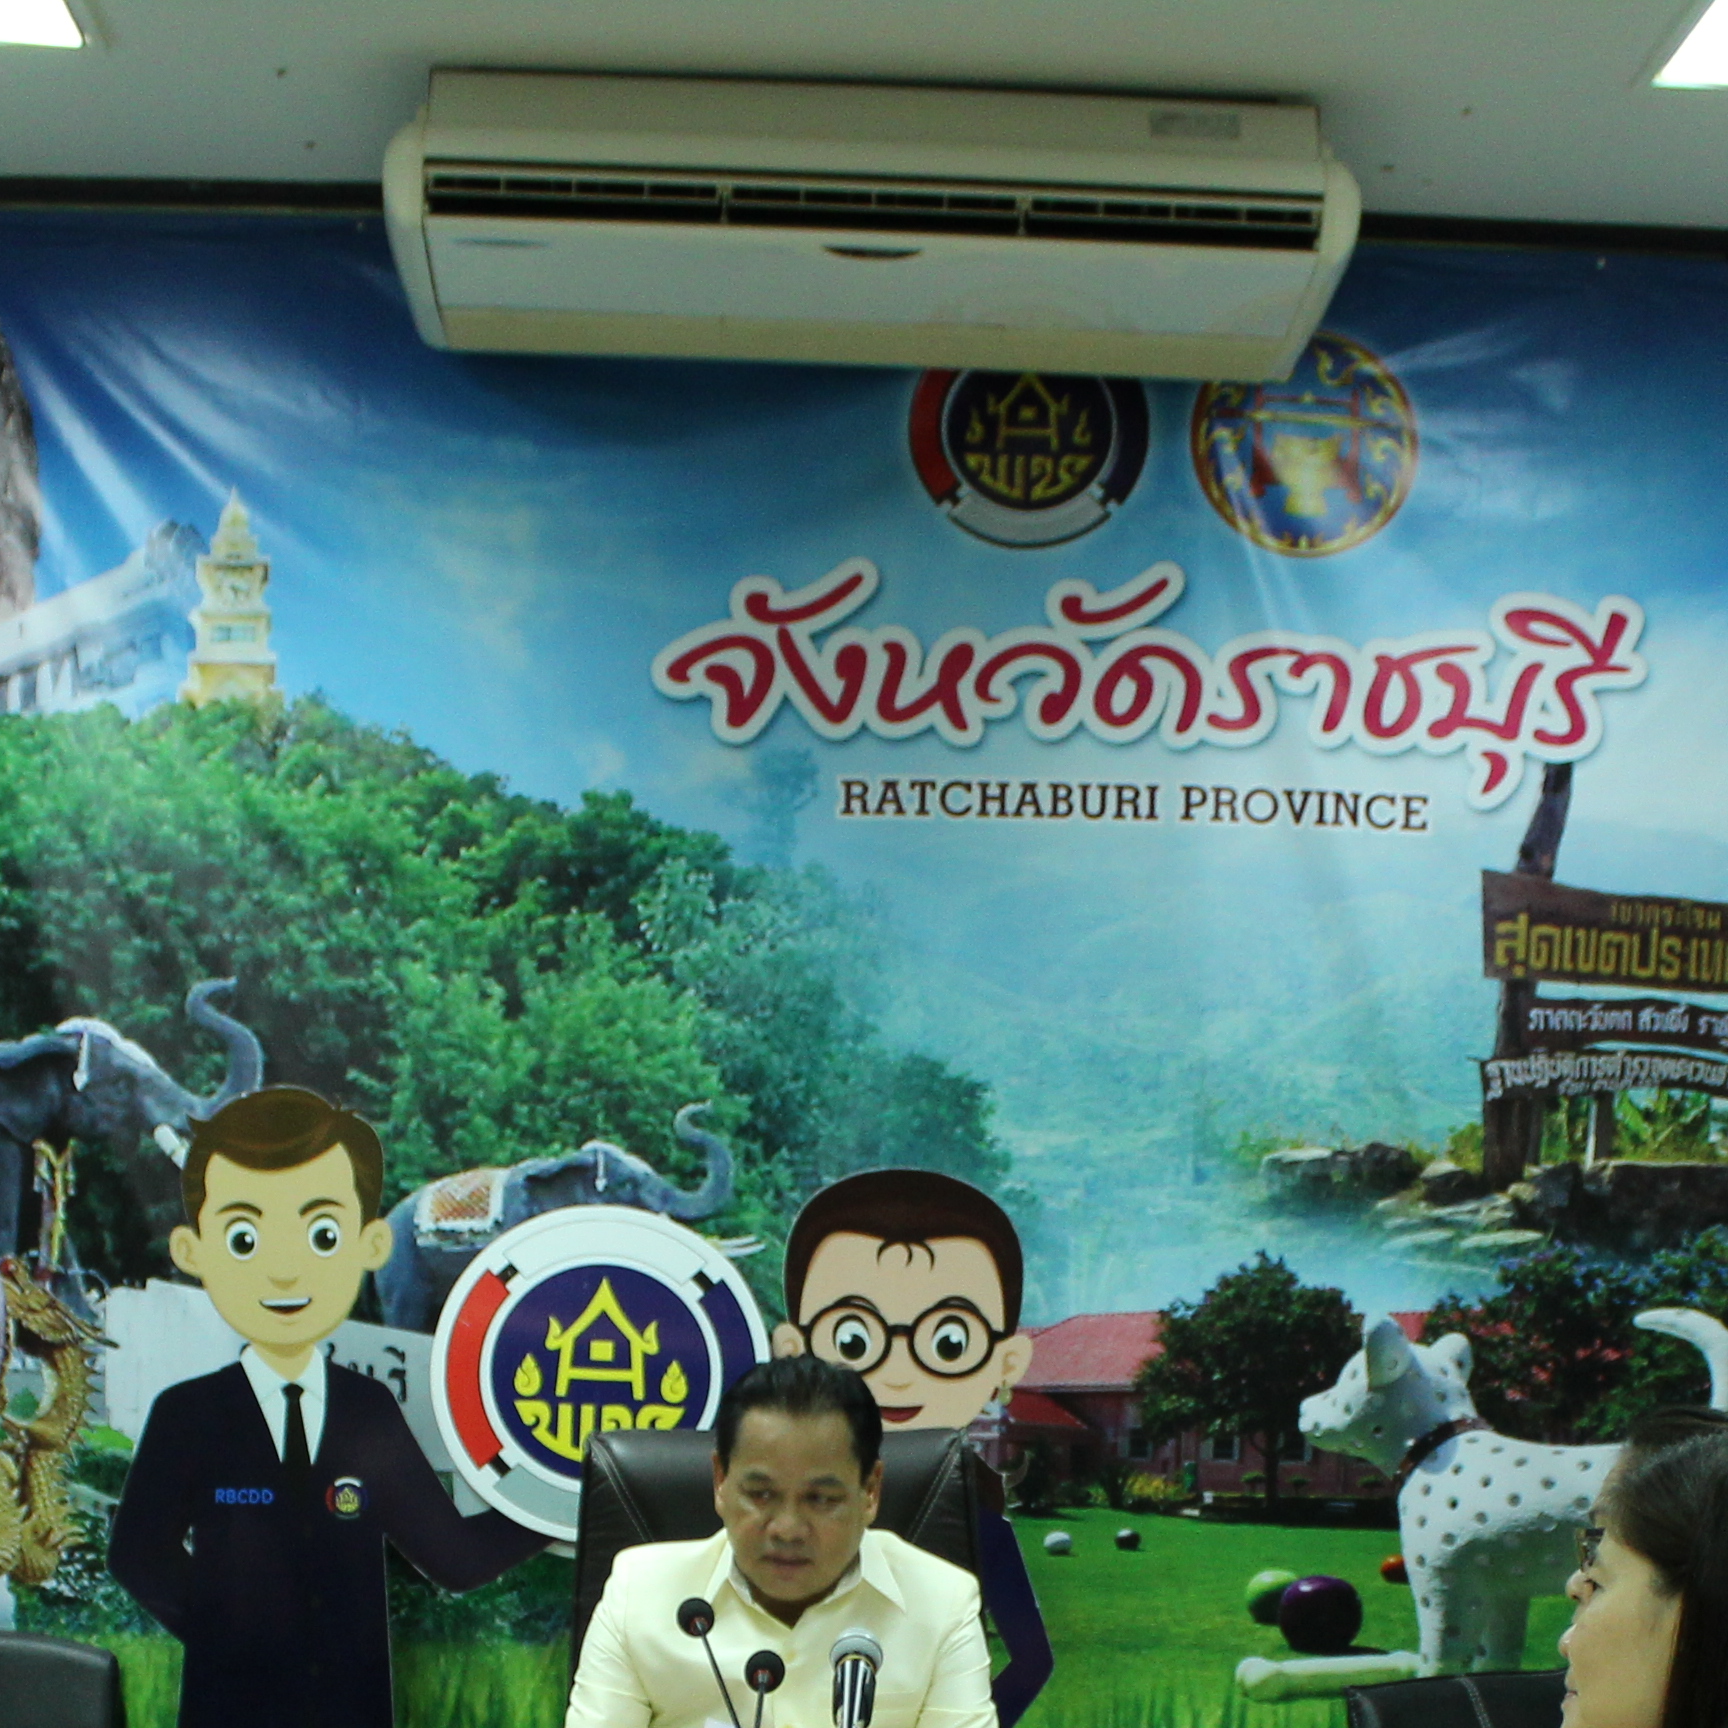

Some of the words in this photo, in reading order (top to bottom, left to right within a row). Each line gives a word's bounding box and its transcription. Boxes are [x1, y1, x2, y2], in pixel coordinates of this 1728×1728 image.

[665, 568, 1633, 796] จังหวัดราชบุรี
[840, 778, 1160, 822] RATCHABURI
[1179, 784, 1430, 833] PROVINCE
[214, 1488, 275, 1504] RBCDD
